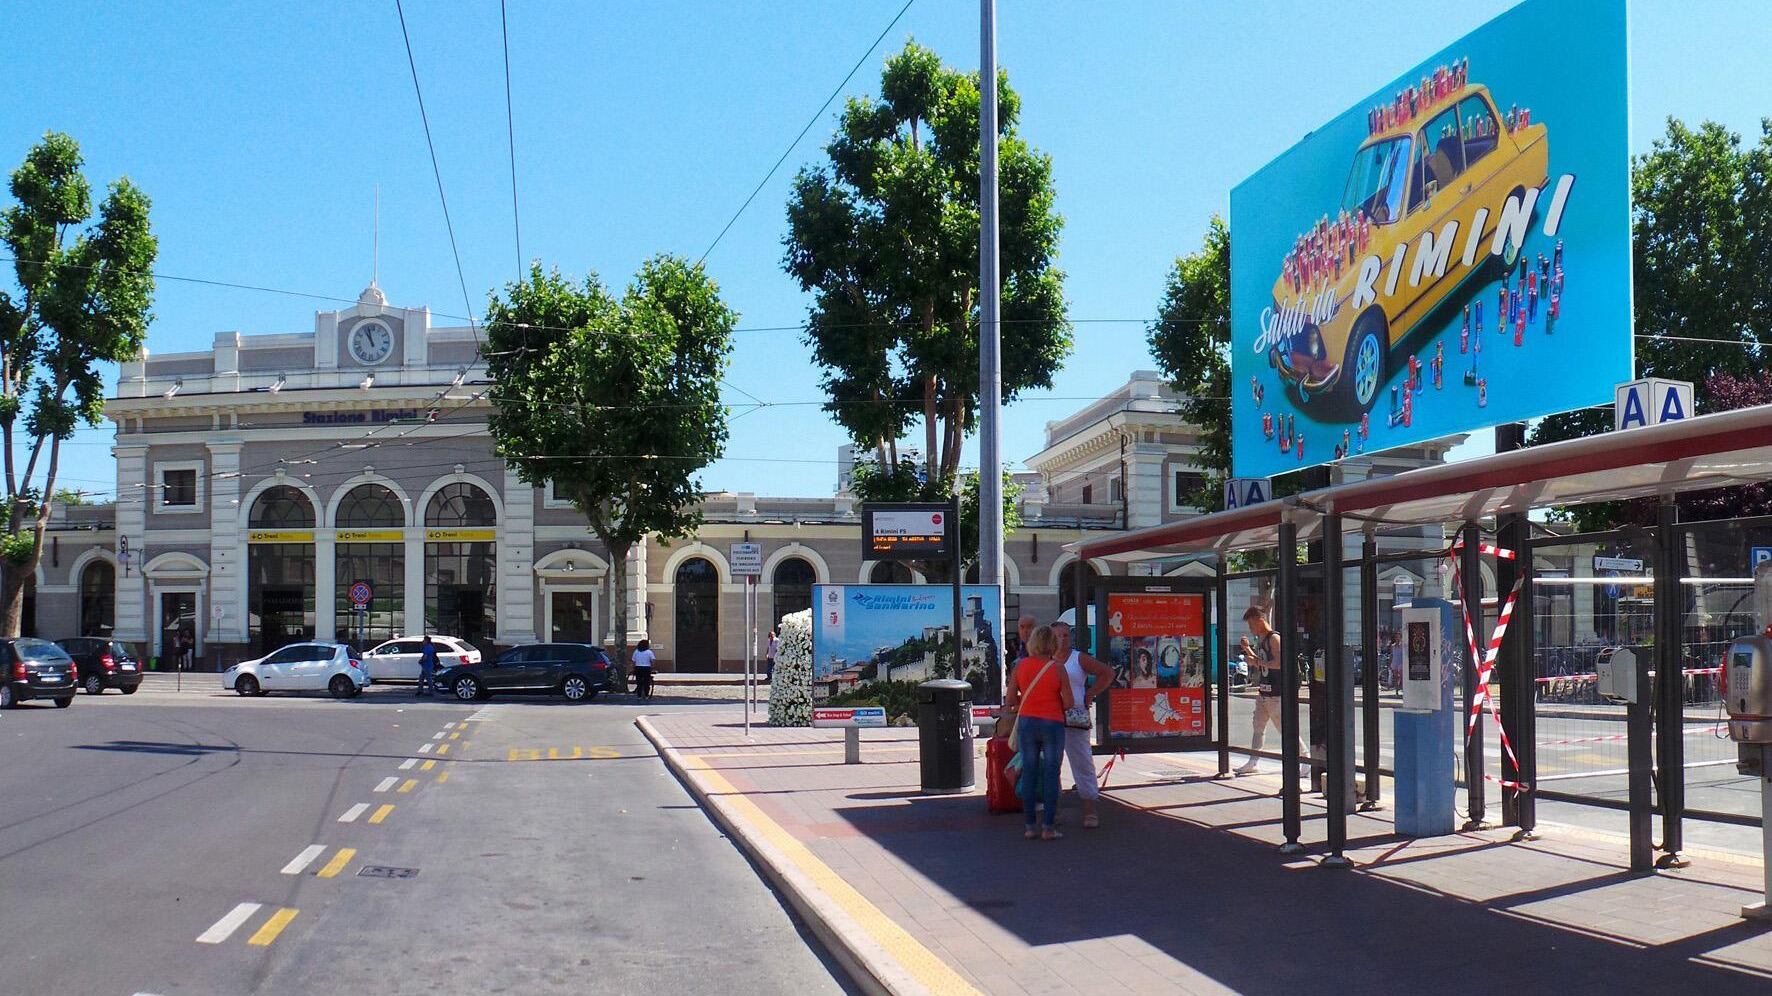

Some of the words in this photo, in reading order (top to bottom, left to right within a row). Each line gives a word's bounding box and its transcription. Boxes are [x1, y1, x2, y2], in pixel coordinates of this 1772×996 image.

[1253, 287, 1310, 354] Saluti
[1310, 277, 1337, 326] da
[1352, 173, 1576, 309] RIMINI
[303, 411, 366, 424] Stazione
[371, 408, 417, 422] Rimini
[1621, 387, 1647, 430] A
[1659, 386, 1685, 423] A
[1227, 482, 1237, 510] A
[1245, 481, 1265, 506] A
[873, 593, 913, 604] Rimini
[508, 745, 621, 761] BUS
